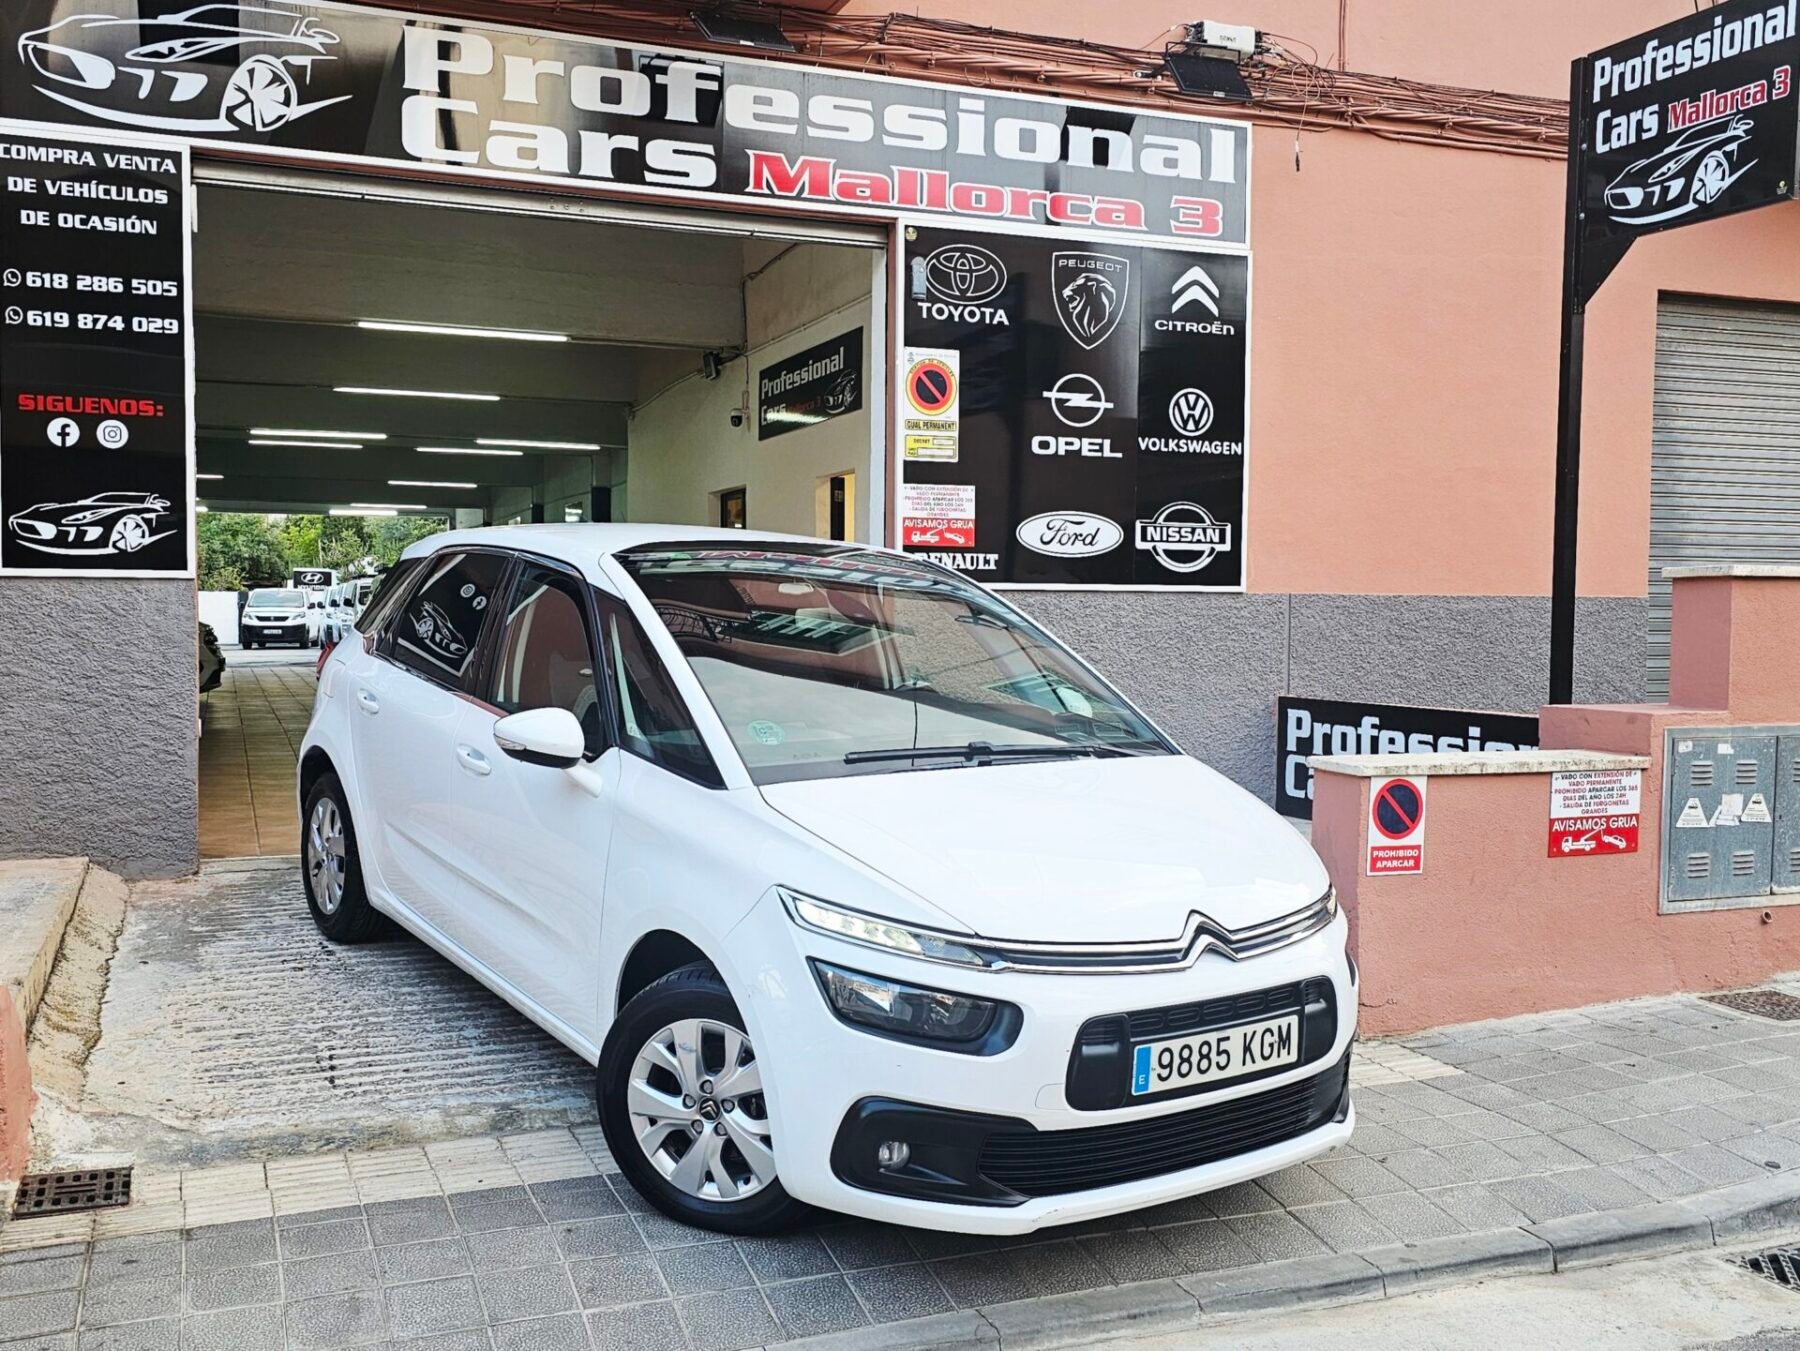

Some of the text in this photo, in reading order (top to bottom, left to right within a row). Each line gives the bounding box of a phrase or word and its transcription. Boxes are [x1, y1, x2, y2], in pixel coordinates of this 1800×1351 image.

[1593, 0, 1797, 103] Professional
[402, 25, 1236, 184] Professional
[1595, 65, 1791, 154] Cars Mallorca 3
[0, 143, 176, 173] COMPRA VENTA
[401, 95, 1223, 236] Cars Mallorca 3
[7, 176, 168, 204] DE VEHÍCULOS
[20, 209, 157, 235] DE OCASIÓN
[1058, 259, 1122, 273] PEUGEOT
[26, 271, 178, 297] 618 286 505
[26, 311, 179, 335] 619 874 029
[917, 302, 1009, 326] TOYOTA
[761, 346, 844, 400] Professional
[18, 394, 164, 417] SIGUENOS:
[1031, 436, 1123, 458] OPEL
[1138, 437, 1242, 456] VOLKSWAGEN
[904, 519, 974, 529] AVISAMOS GRUA
[1039, 520, 1101, 547] Ford
[1147, 526, 1220, 543] NISSAN
[1287, 708, 1539, 757] Profesi
[1588, 786, 1615, 794] APARCAR
[1581, 807, 1608, 815] GRANDES
[1552, 816, 1638, 832] AVISAMOS GRUA
[1373, 849, 1419, 858] PROHIBIDO
[1376, 859, 1415, 868] APARCAR
[1138, 1022, 1293, 1085] E 9885 KGM
